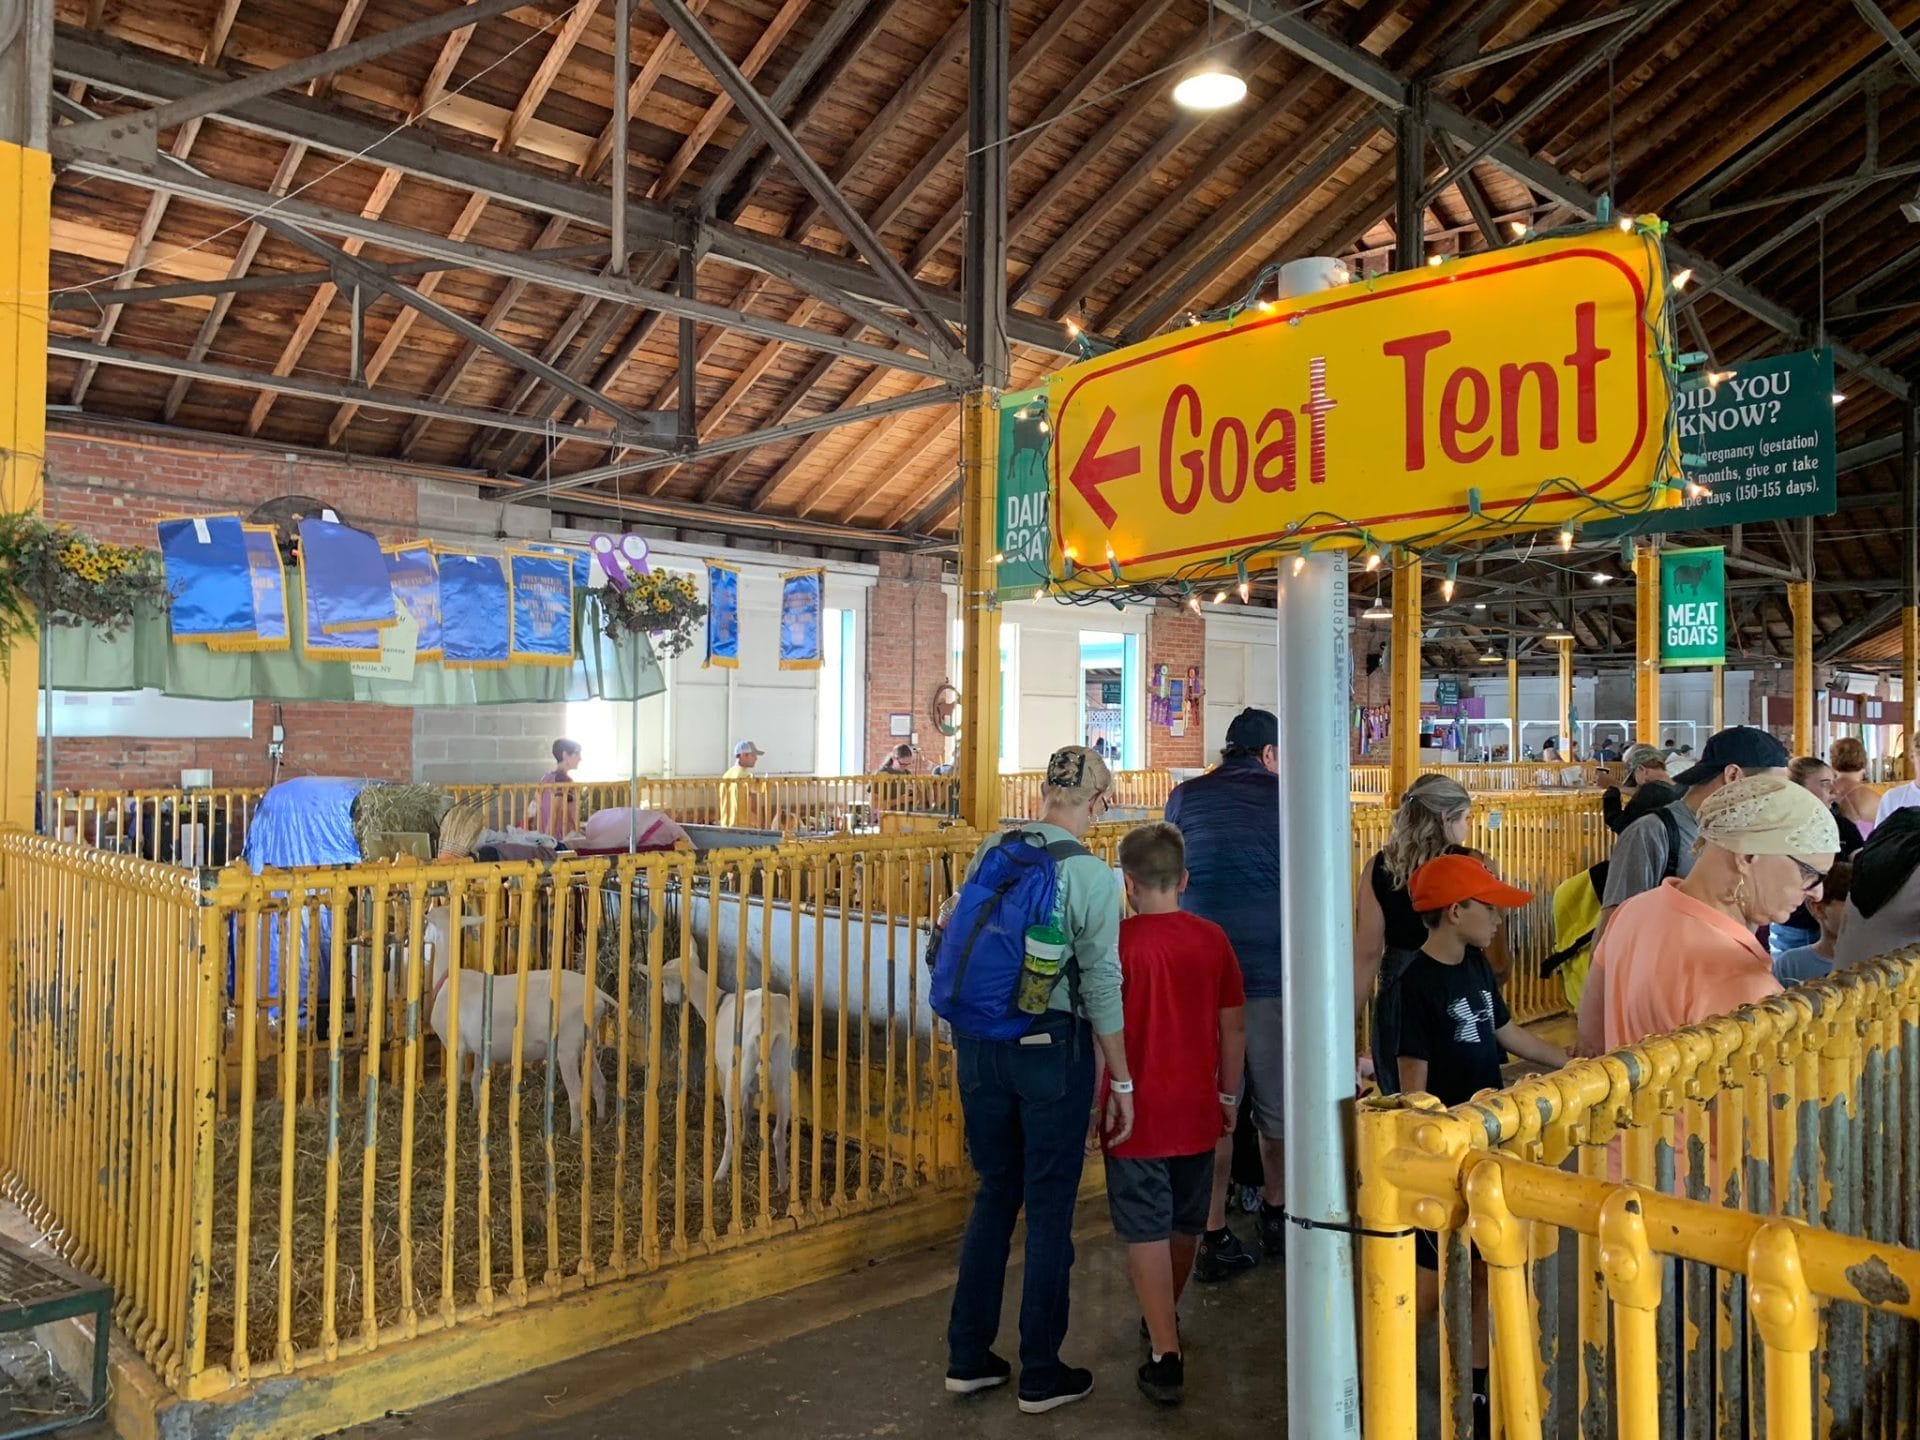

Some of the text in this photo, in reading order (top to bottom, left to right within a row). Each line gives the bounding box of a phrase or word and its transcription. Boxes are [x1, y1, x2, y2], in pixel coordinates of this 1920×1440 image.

[1675, 370, 1791, 412] DID YOU
[1159, 301, 1612, 515] Goat Tent
[1678, 400, 1782, 438] KNOW?
[1759, 430, 1819, 457] (gestation)
[1698, 465, 1741, 485] months,
[1745, 461, 1770, 483] give
[1774, 461, 1788, 474] or
[1792, 454, 1819, 472] take
[1735, 481, 1781, 504] (150-155
[1786, 475, 1820, 497] days).
[1333, 581, 1345, 625] RIGID
[1667, 601, 1719, 627] MEAT
[1667, 626, 1719, 647] GOATS
